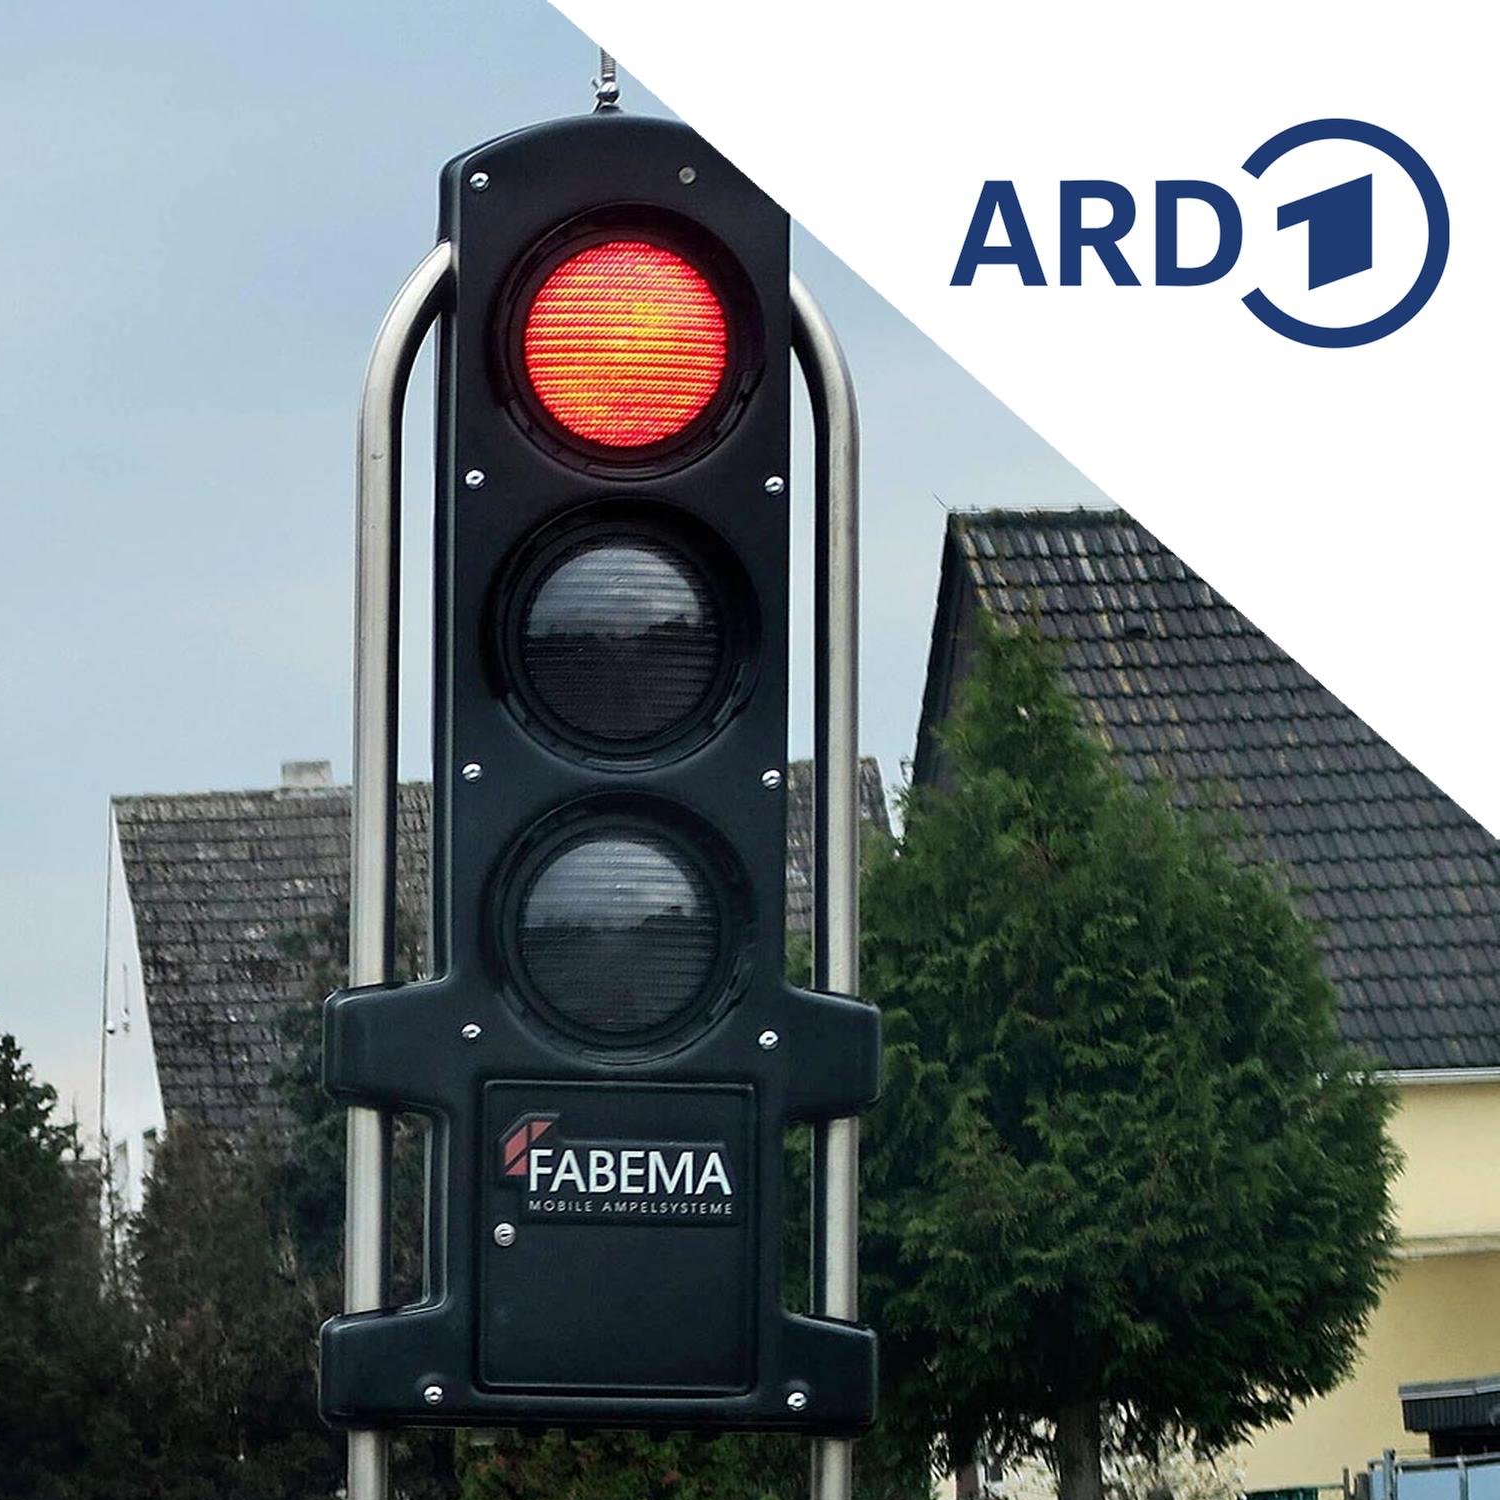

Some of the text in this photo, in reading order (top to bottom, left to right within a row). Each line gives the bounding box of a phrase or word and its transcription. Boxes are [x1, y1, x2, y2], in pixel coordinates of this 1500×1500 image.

[528, 1148, 733, 1196] FABEMA
[528, 1199, 733, 1215] MOBILE AMPELSYSTEME
